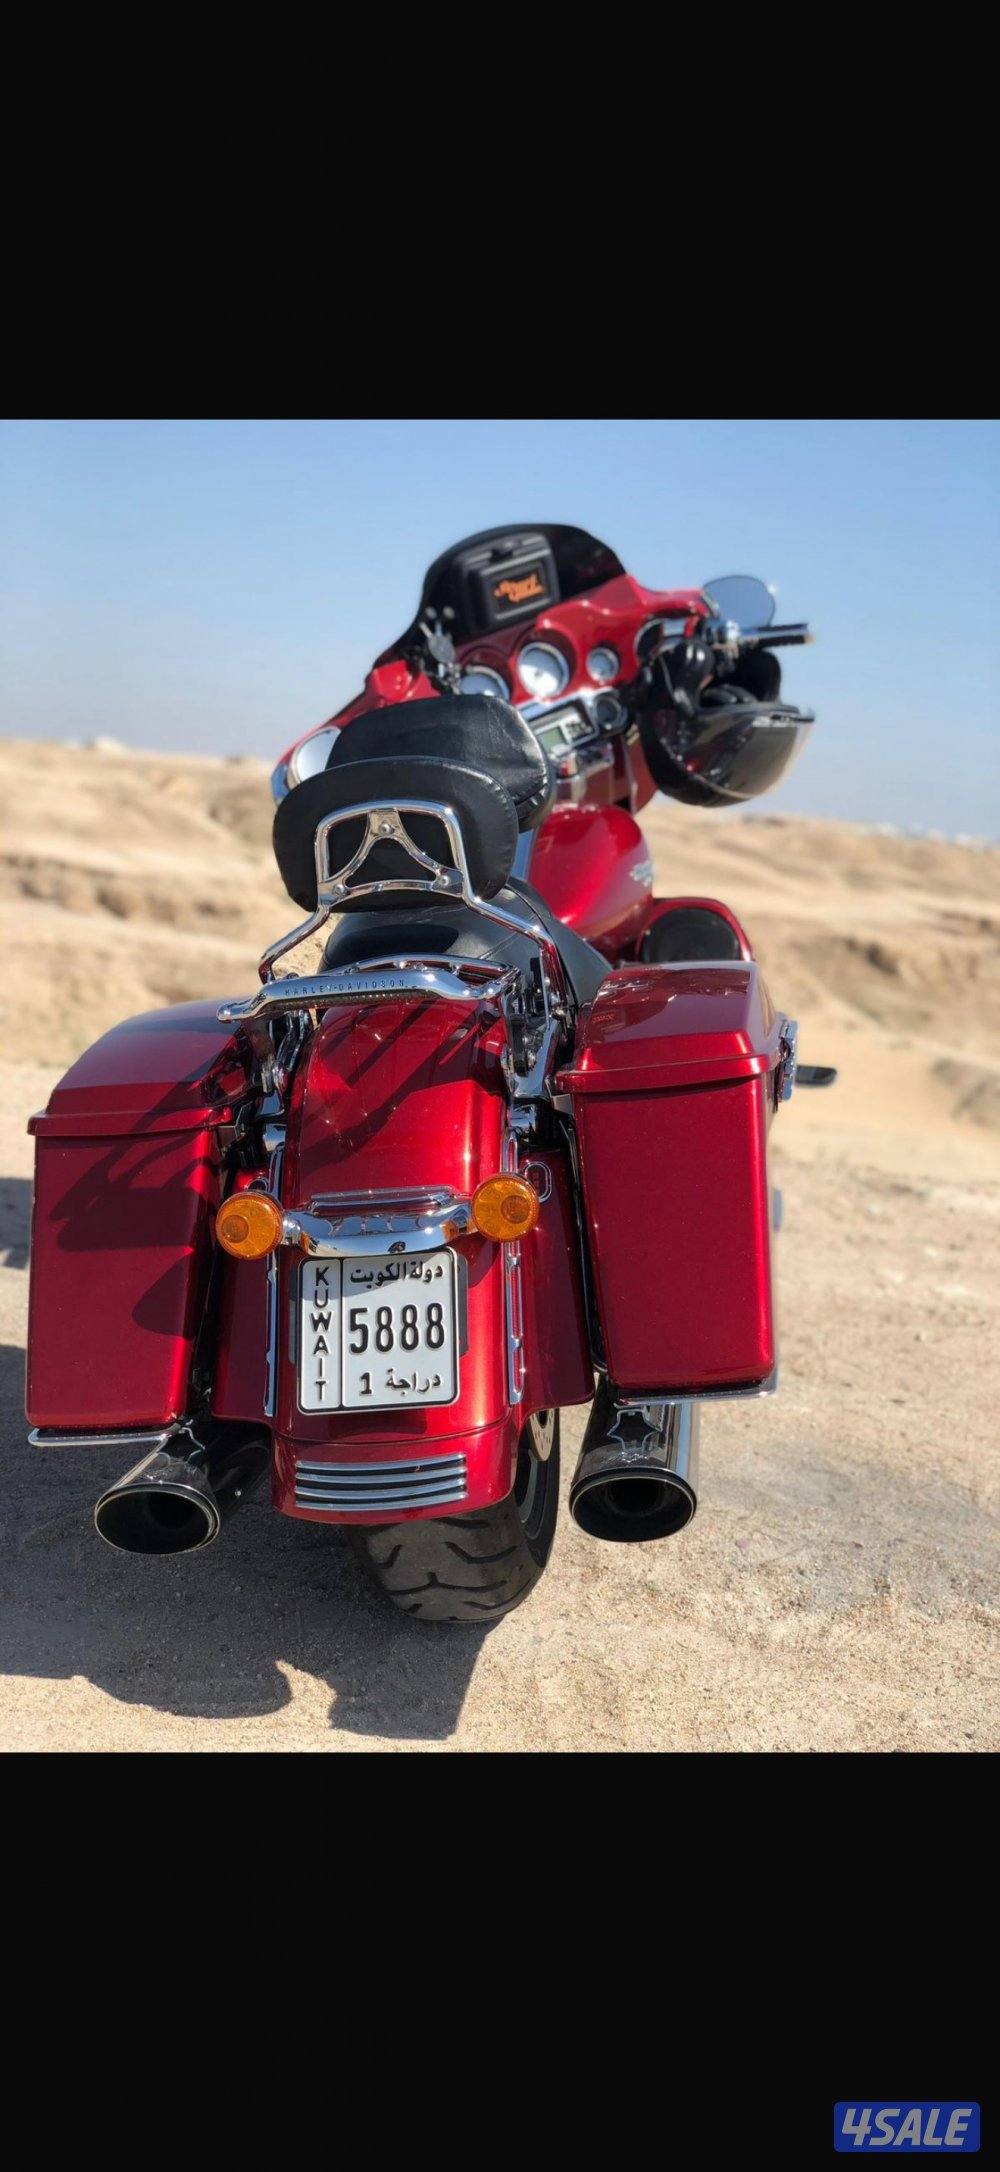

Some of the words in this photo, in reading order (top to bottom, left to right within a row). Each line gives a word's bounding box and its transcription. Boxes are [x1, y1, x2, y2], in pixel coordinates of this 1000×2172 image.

[284, 979, 405, 996] HARLEY-DAVIDSON
[350, 1261, 407, 1289] الكويت
[409, 1260, 444, 1283] دولة
[310, 1266, 332, 1401] KUWAIT
[349, 1302, 445, 1354] 5888
[359, 1371, 373, 1395] 1
[385, 1367, 442, 1396] دراجة
